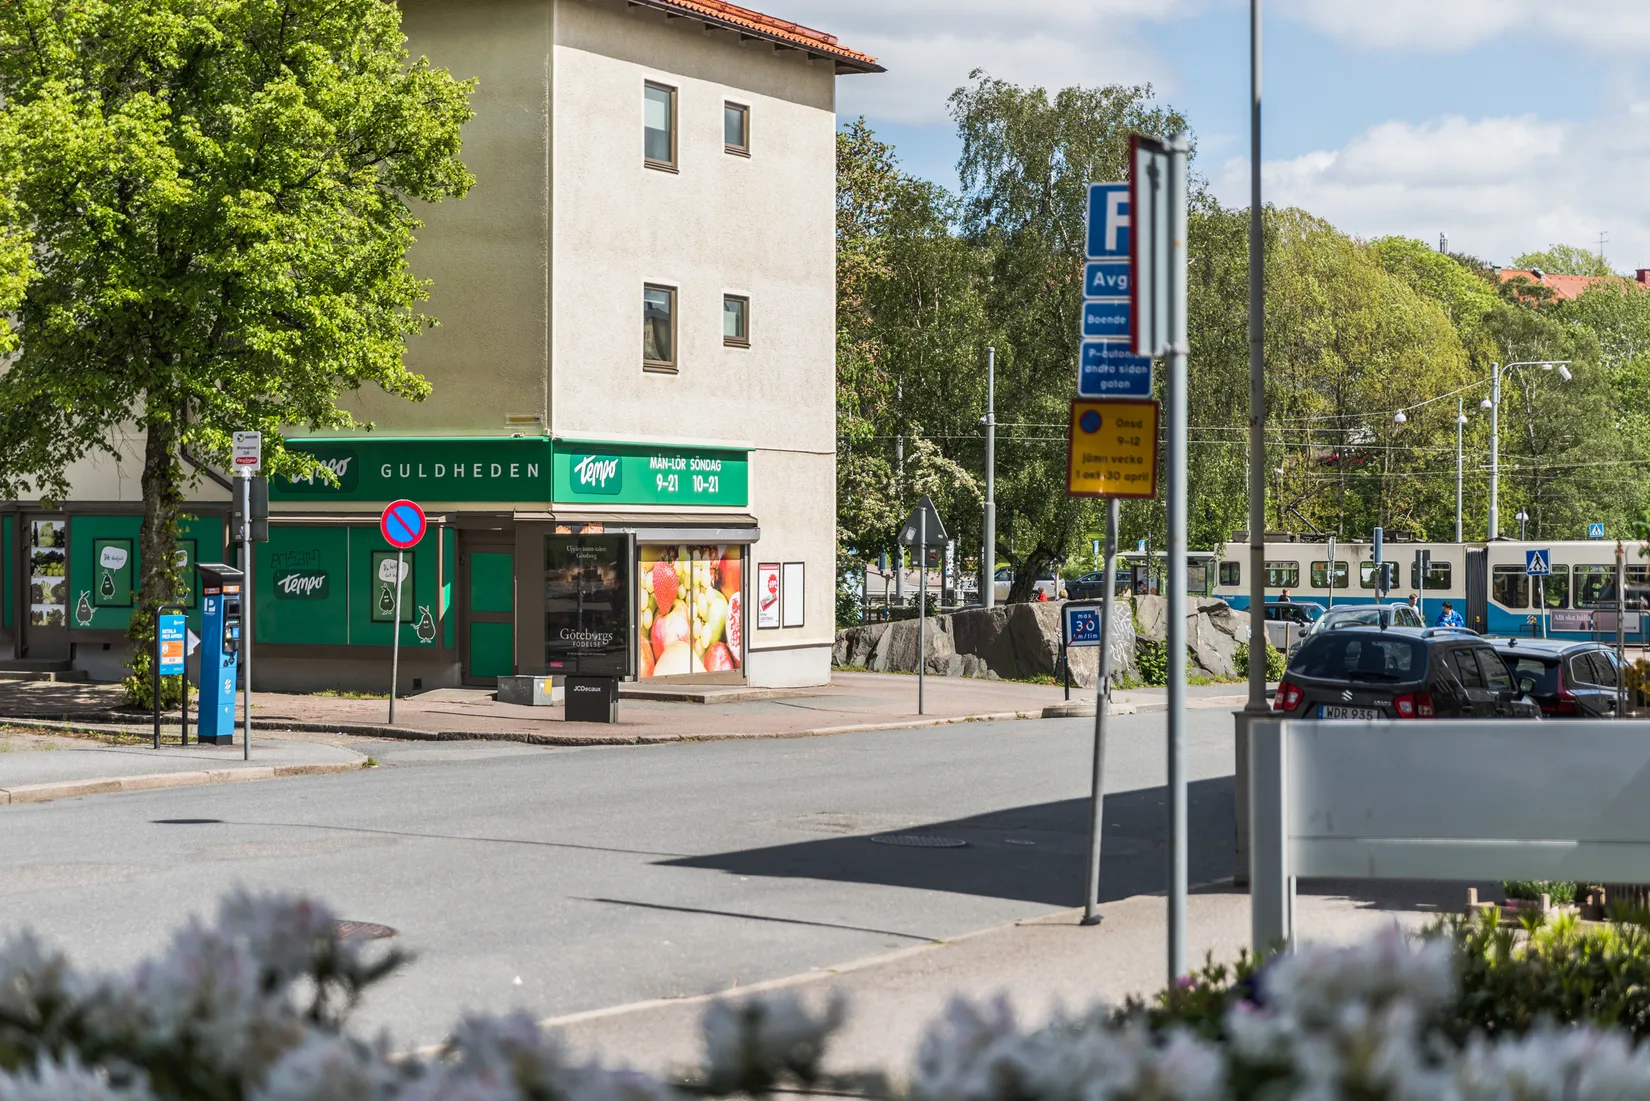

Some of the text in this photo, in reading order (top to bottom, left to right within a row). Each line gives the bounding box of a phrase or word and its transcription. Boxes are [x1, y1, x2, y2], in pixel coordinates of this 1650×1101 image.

[1087, 314, 1126, 324] Boende
[1084, 363, 1148, 373] andra sidan
[1100, 380, 1131, 390] gatan
[1116, 418, 1143, 429] Onsd
[1117, 436, 1141, 446] 9-12
[649, 453, 686, 470] MÅN-LÖR
[690, 455, 721, 471] SÖNDAG
[1111, 455, 1144, 464] vecka
[381, 463, 539, 478] GULDHEDEN
[656, 473, 719, 492] 9-21 10-21
[1124, 471, 1150, 483] april
[1076, 620, 1095, 632] 30
[560, 628, 613, 645] Göteborgs
[1327, 707, 1373, 720] WDR 935
